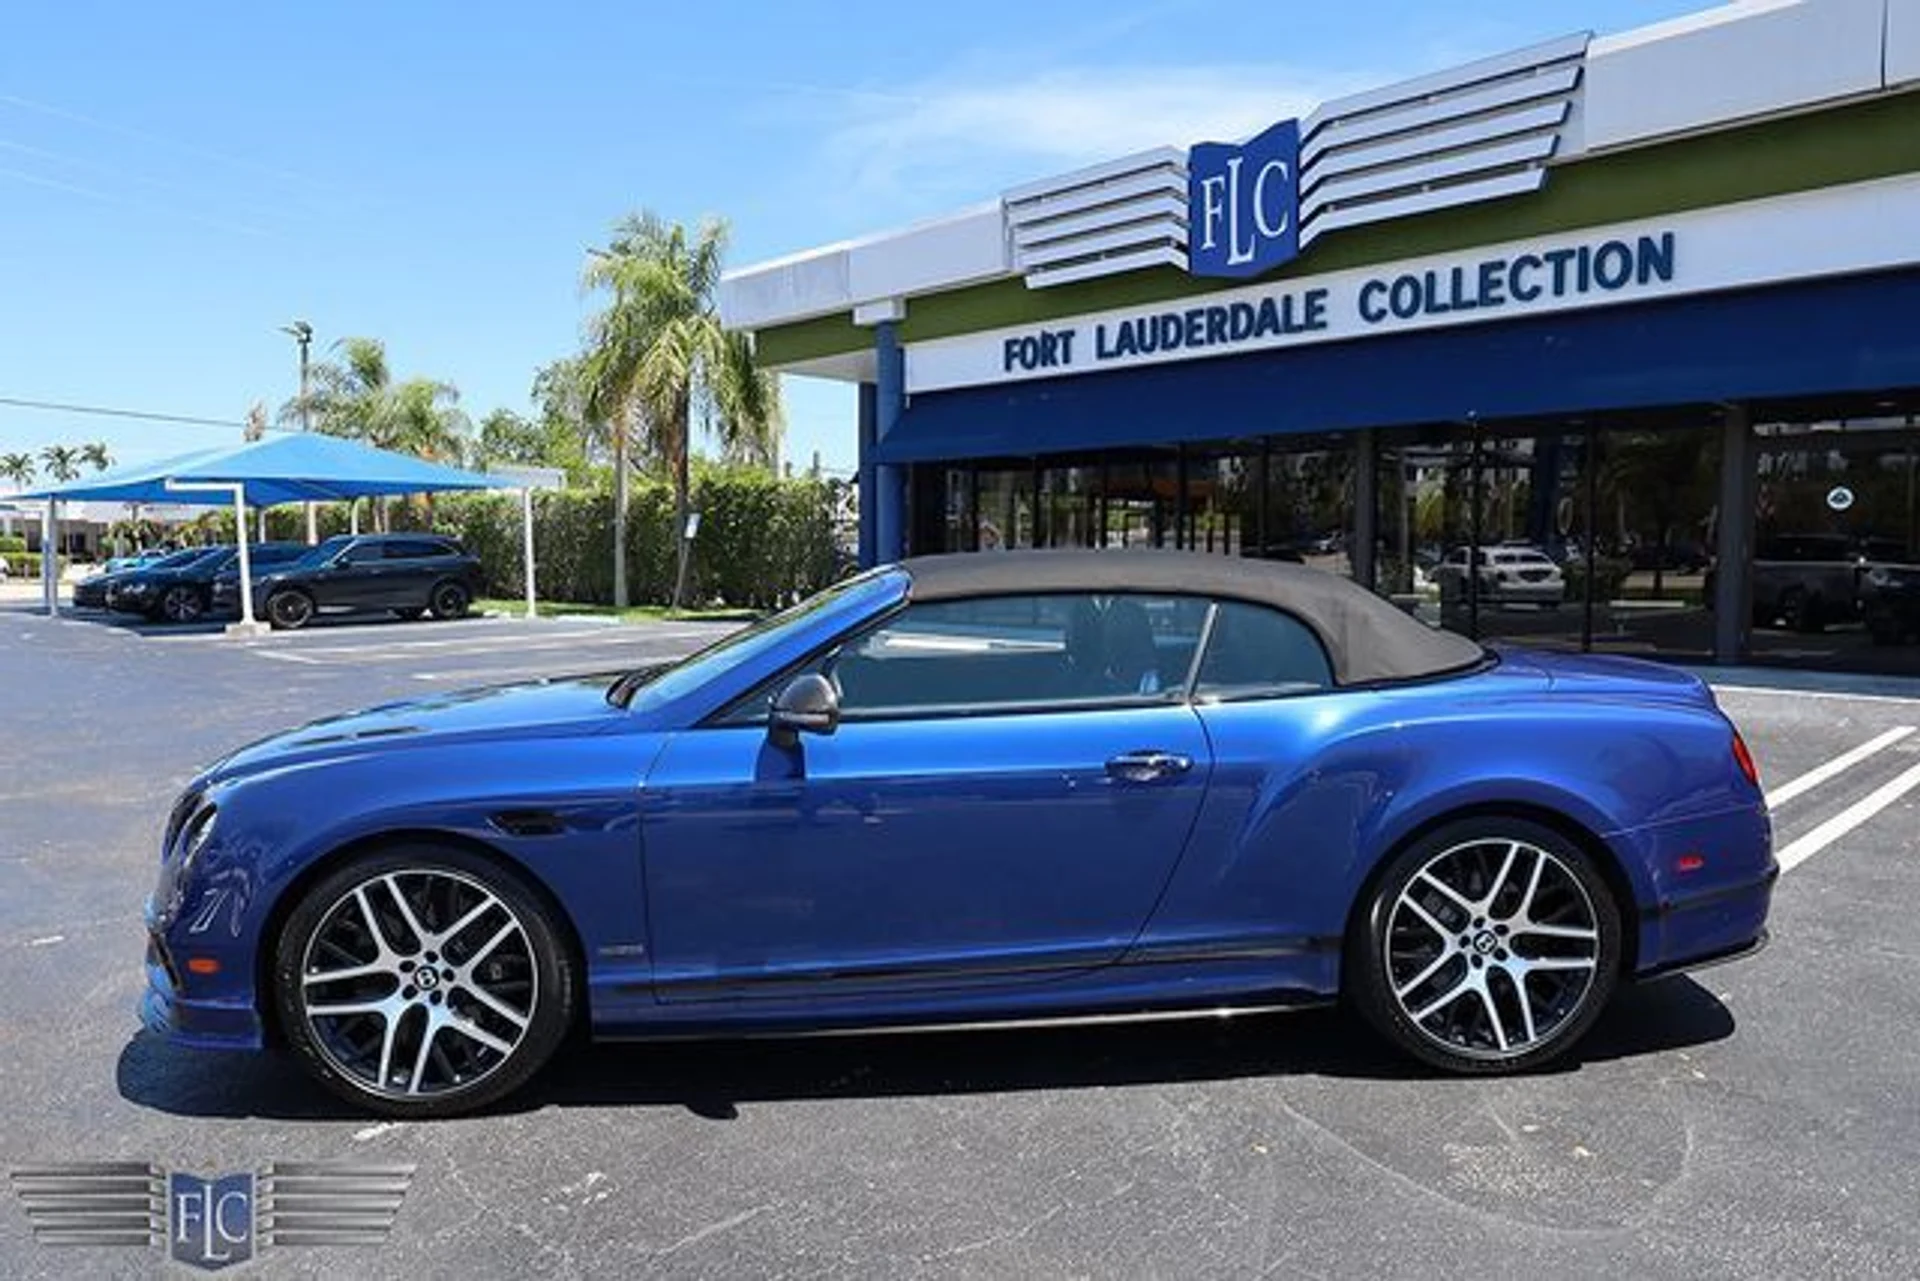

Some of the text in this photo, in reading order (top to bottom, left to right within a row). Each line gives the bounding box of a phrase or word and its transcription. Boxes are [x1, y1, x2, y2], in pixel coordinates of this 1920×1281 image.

[1201, 156, 1289, 265] FLC
[1004, 231, 1675, 371] FORT LAUDERDALE COLLECTION
